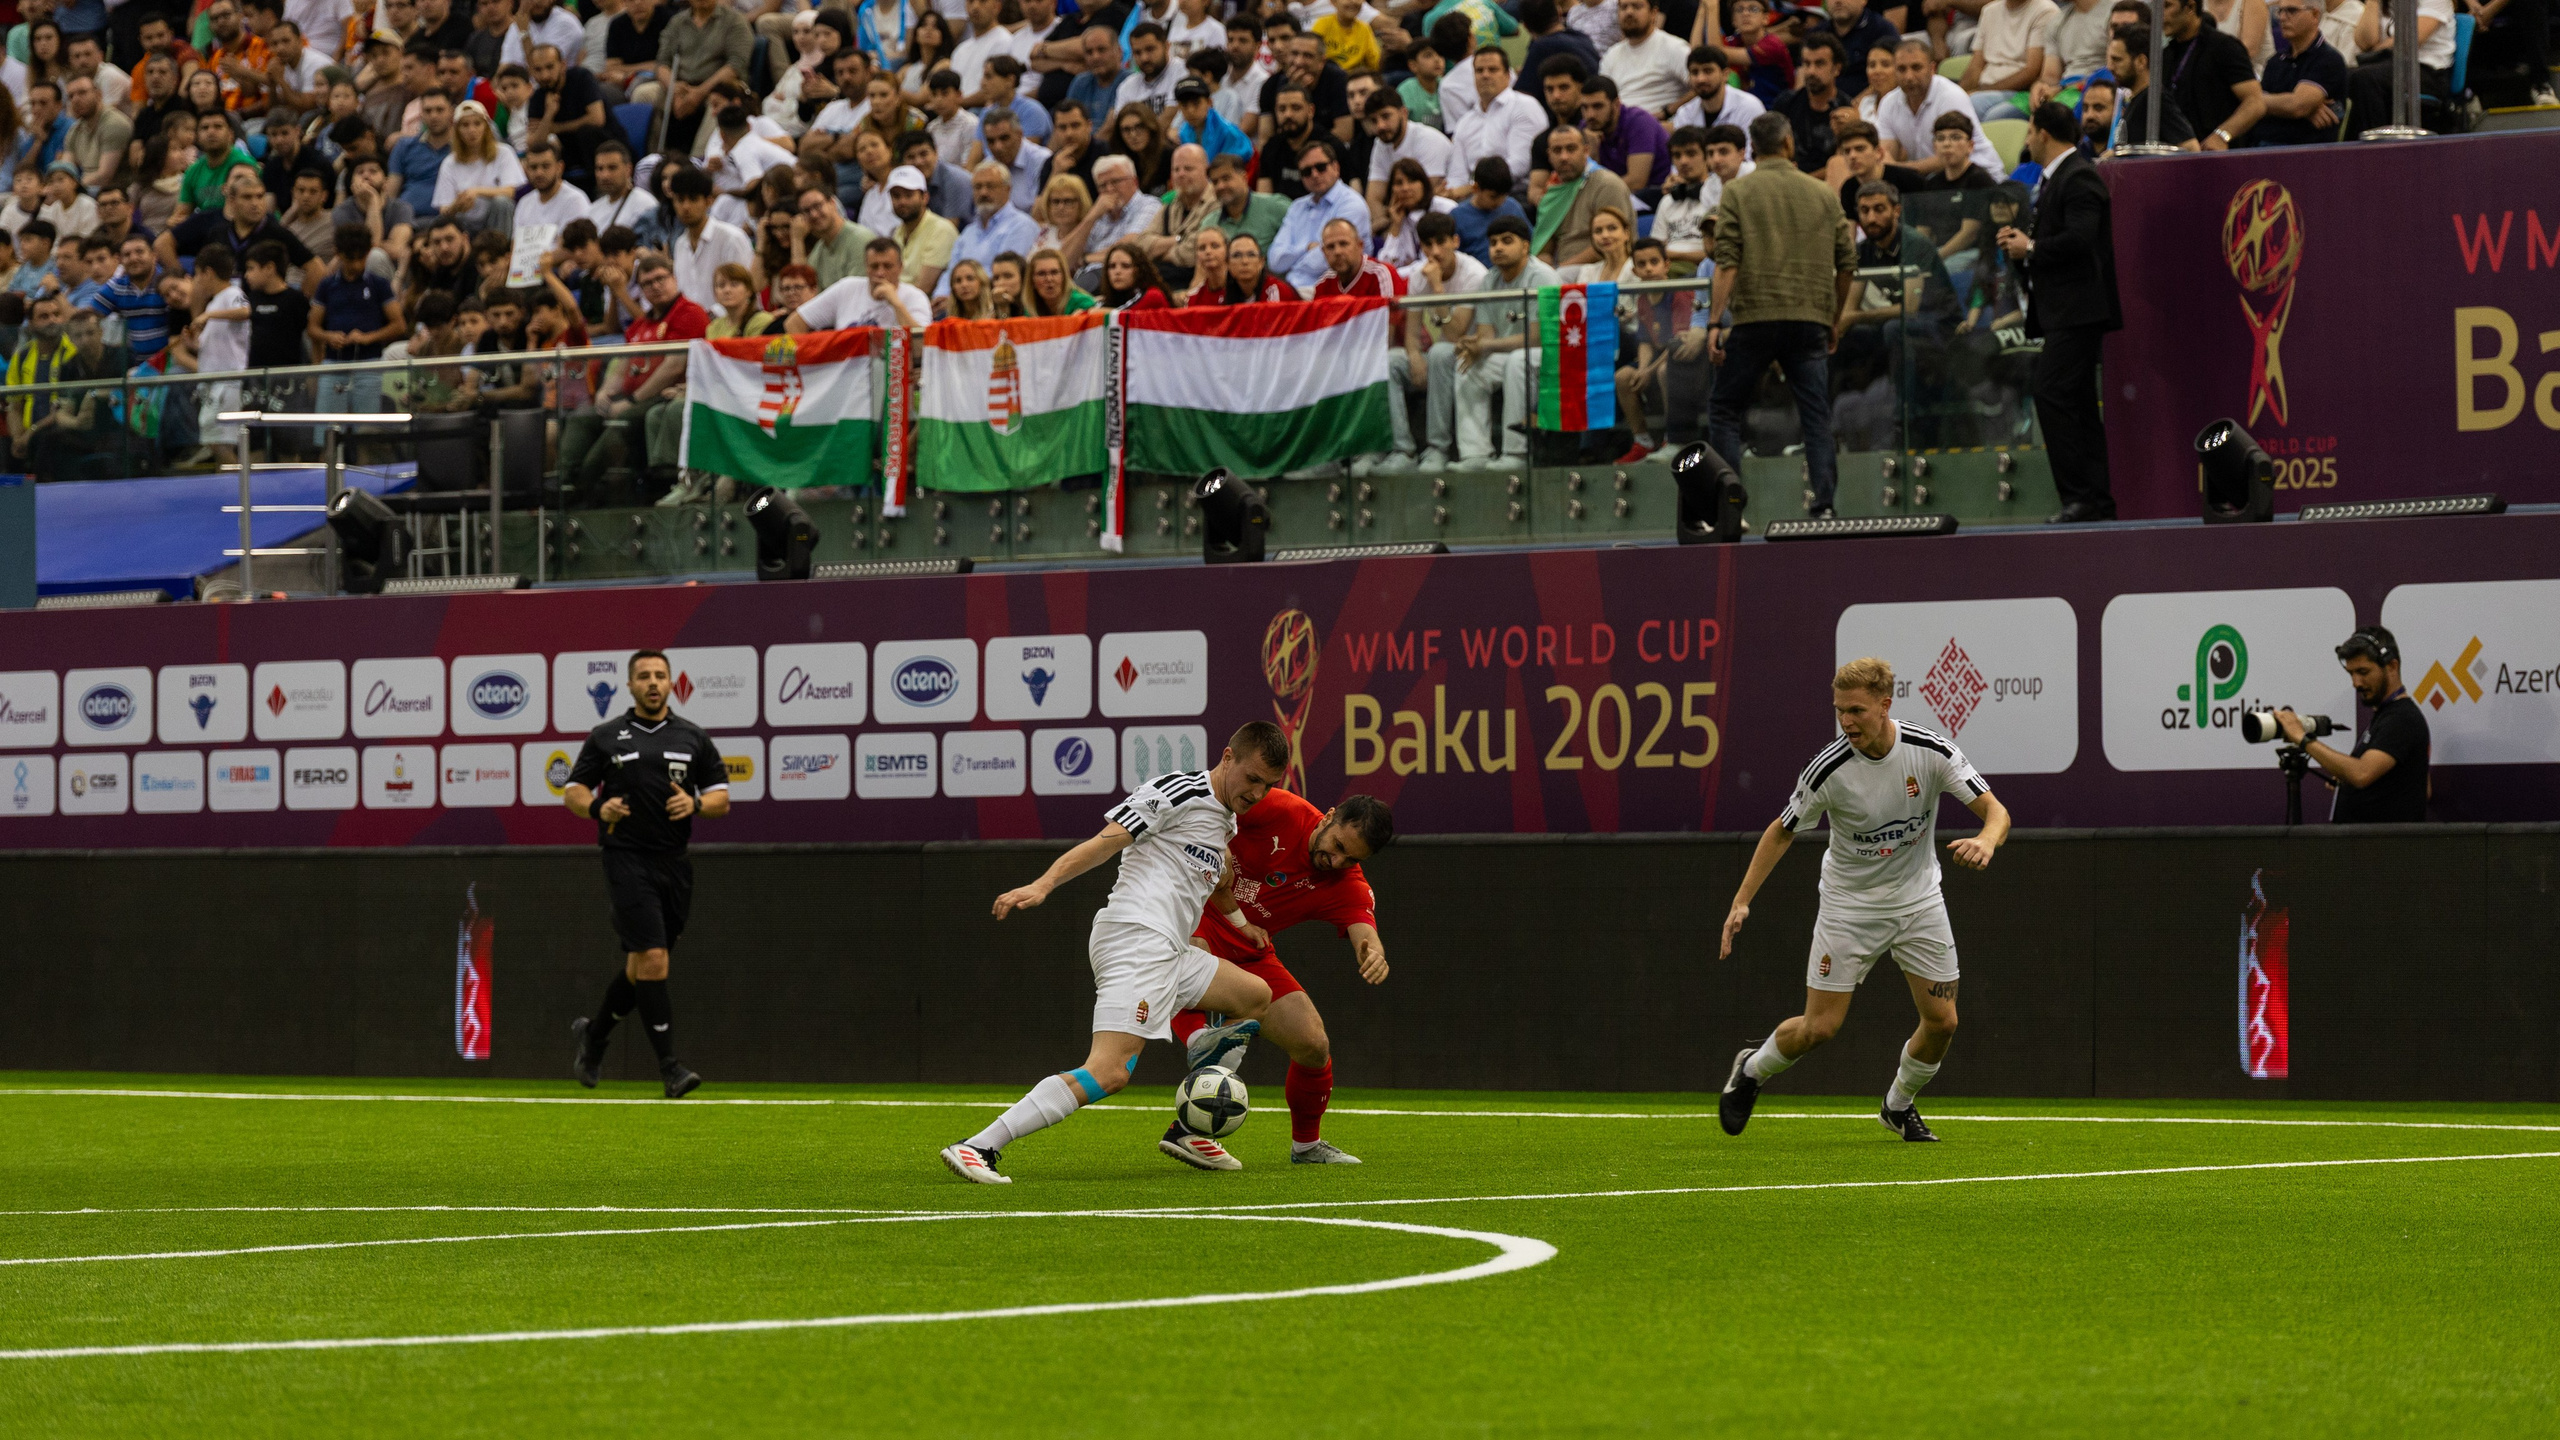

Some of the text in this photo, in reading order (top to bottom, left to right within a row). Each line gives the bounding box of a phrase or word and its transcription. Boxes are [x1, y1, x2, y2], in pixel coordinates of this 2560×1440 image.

[2257, 436, 2338, 455] ORLD CUP
[2273, 457, 2338, 490] 2025
[1022, 646, 1055, 660] BIZON
[1345, 618, 1722, 672] WMF WORLD CUP
[587, 660, 618, 675] BIZON
[899, 669, 950, 692] atena
[1993, 676, 2044, 702] group
[473, 682, 522, 705] atena
[805, 681, 853, 700] Azercell
[84, 693, 130, 717] atena
[389, 695, 433, 712] Azercell
[6, 705, 47, 725] Azercell
[1344, 681, 1721, 776] Baku 2025
[878, 754, 928, 772] SMTS
[966, 756, 1017, 771] TuranBank
[293, 768, 348, 785] FERRO
